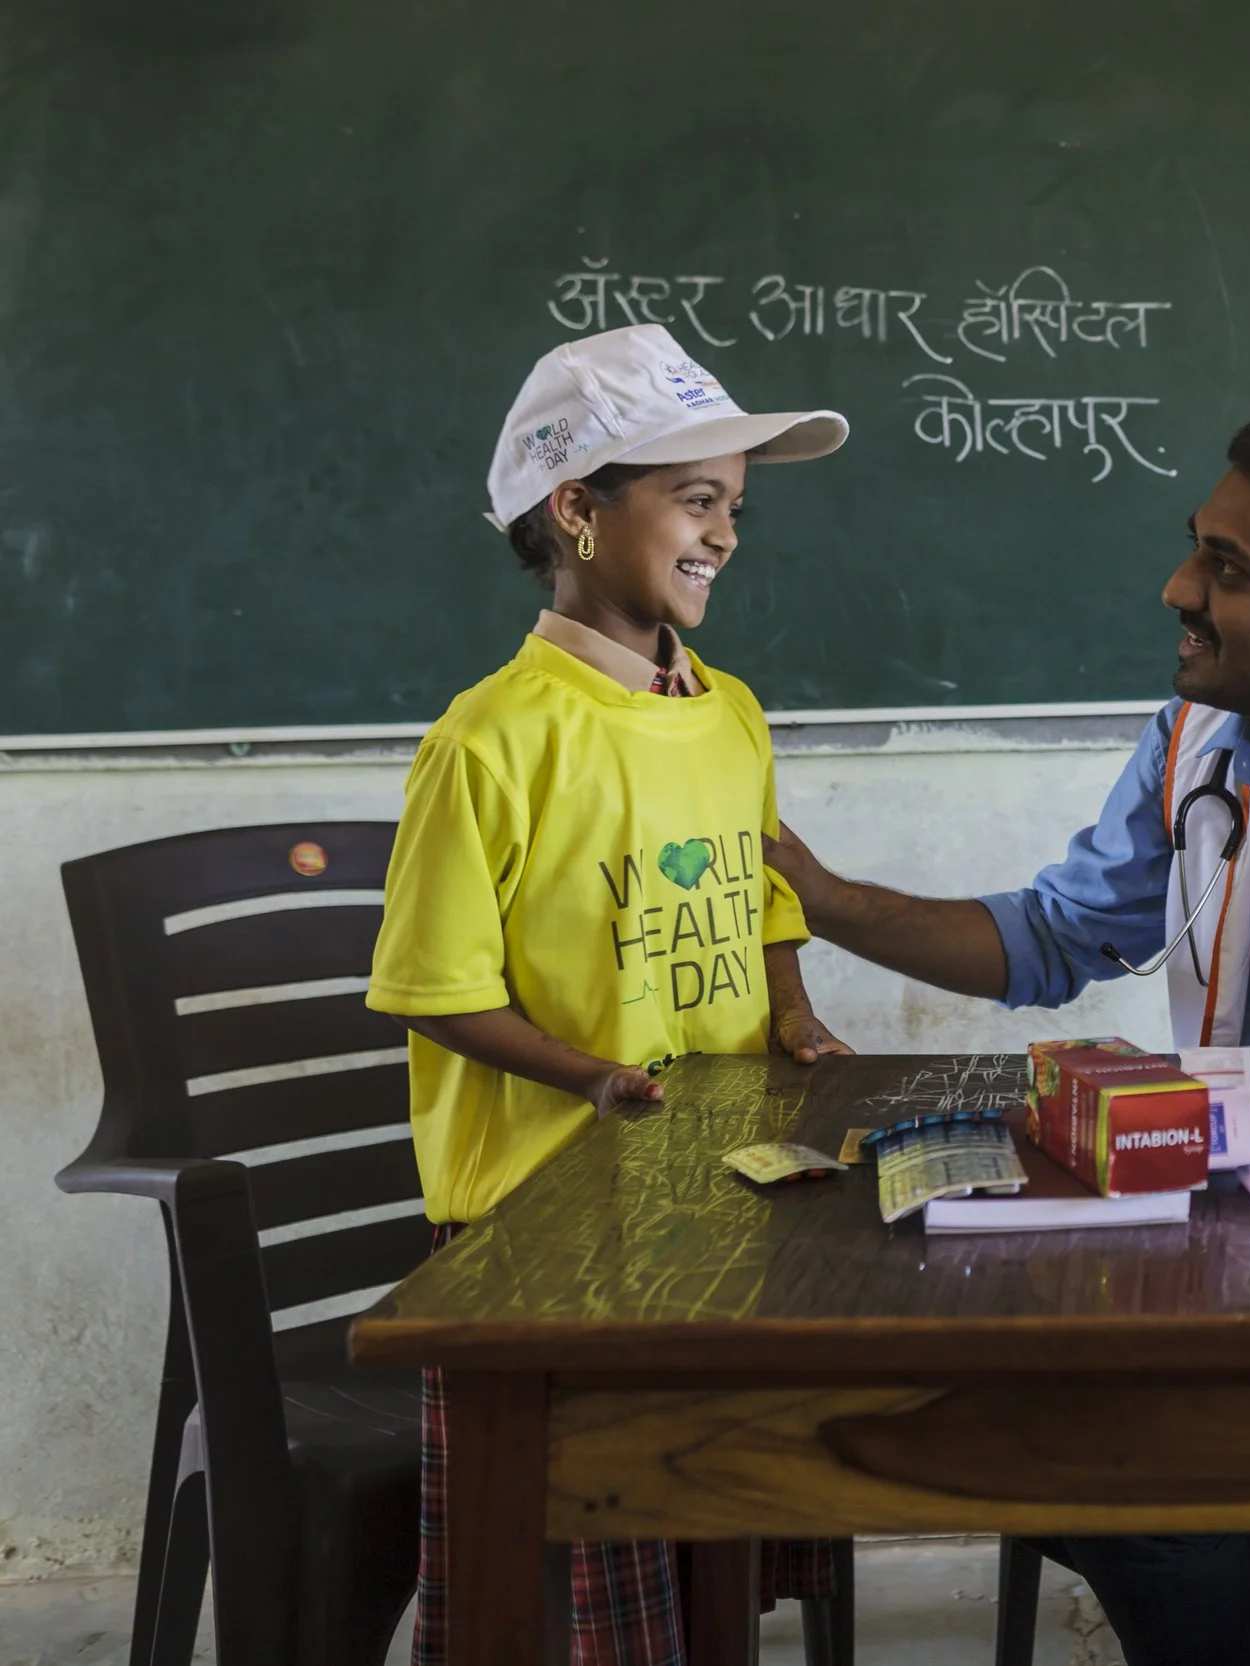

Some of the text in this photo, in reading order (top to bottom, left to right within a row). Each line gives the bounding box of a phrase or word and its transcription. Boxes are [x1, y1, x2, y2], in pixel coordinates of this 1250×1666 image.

[750, 275, 952, 363] आधार
[958, 266, 1171, 361] हॉस्पिटल
[676, 387, 706, 402] Aster
[522, 417, 569, 450] WRLD
[529, 431, 575, 462] HEALTH
[545, 448, 569, 470] DAY
[598, 831, 754, 910] WRLD
[670, 946, 751, 1012] DAY
[1115, 1127, 1204, 1151] INTABION-L
